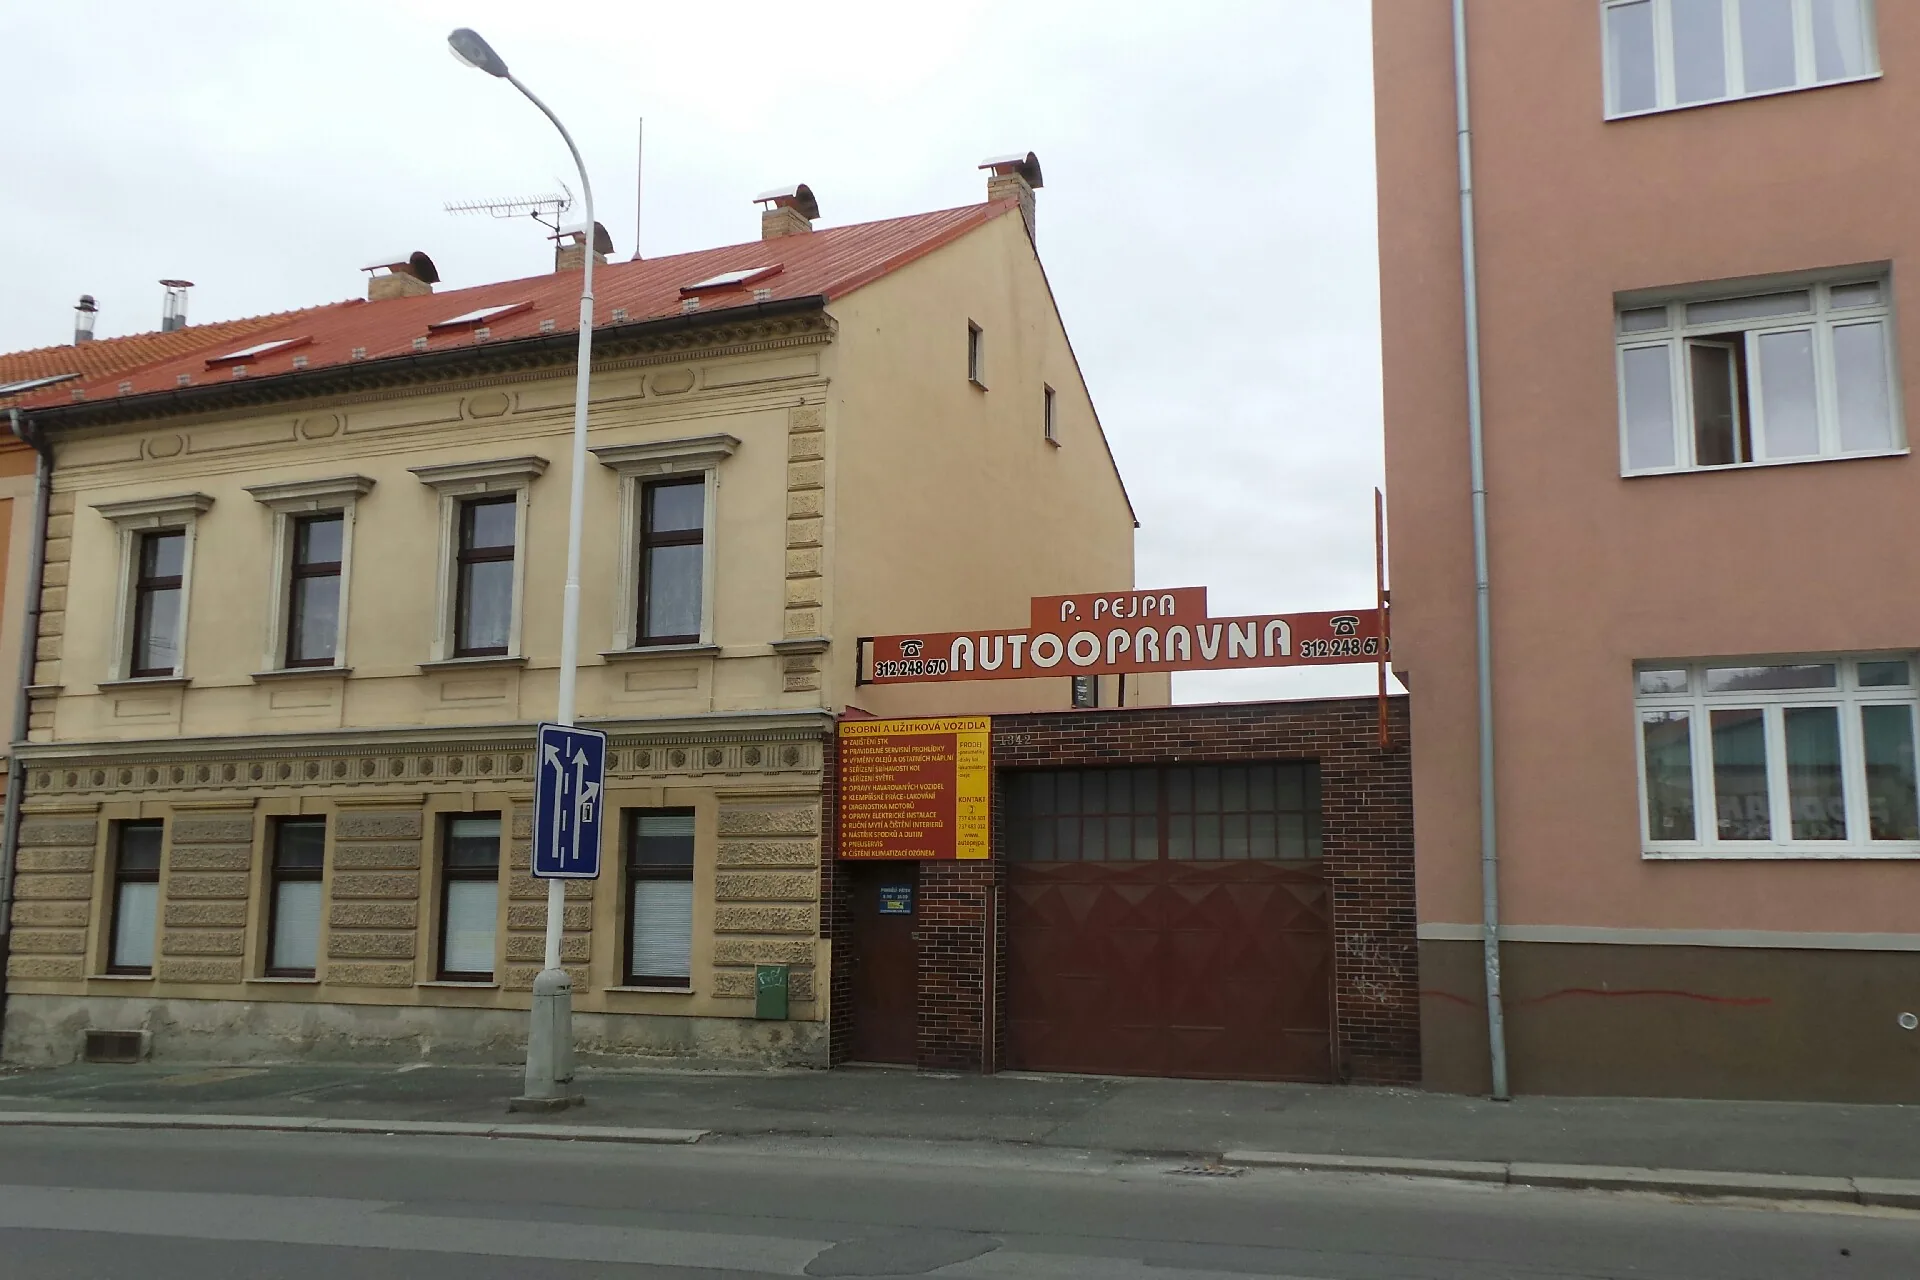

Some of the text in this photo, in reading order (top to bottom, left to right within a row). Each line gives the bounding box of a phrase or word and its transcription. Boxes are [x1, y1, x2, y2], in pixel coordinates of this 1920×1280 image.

[1061, 594, 1175, 621] P. PEJPA
[950, 619, 1291, 671] AUTOOPRAVNA
[1300, 639, 1329, 658] 312
[1330, 637, 1360, 656] 248
[875, 658, 948, 677] 312 248 670
[843, 721, 986, 734] OSOBNÍ A UŽITKOVÁ VOZIDLA
[1000, 735, 1031, 746] 1342
[884, 745, 911, 754] SERVISNÍ
[911, 745, 945, 753] PROHLÍDKY
[875, 755, 892, 764] OLEJŮ
[898, 755, 931, 763] OSTATNÍCH
[931, 754, 954, 762] NÁPLNÍ
[919, 783, 944, 791] VOZIDEL
[888, 801, 915, 810] MOTORŮ
[849, 811, 937, 820] OPRAVY ELEKTRICKÉ INSTALACE
[849, 821, 867, 829] RUČNÍ
[849, 840, 884, 848] PNEUSERVIS
[871, 848, 908, 857] KLIMATIZACÍ
